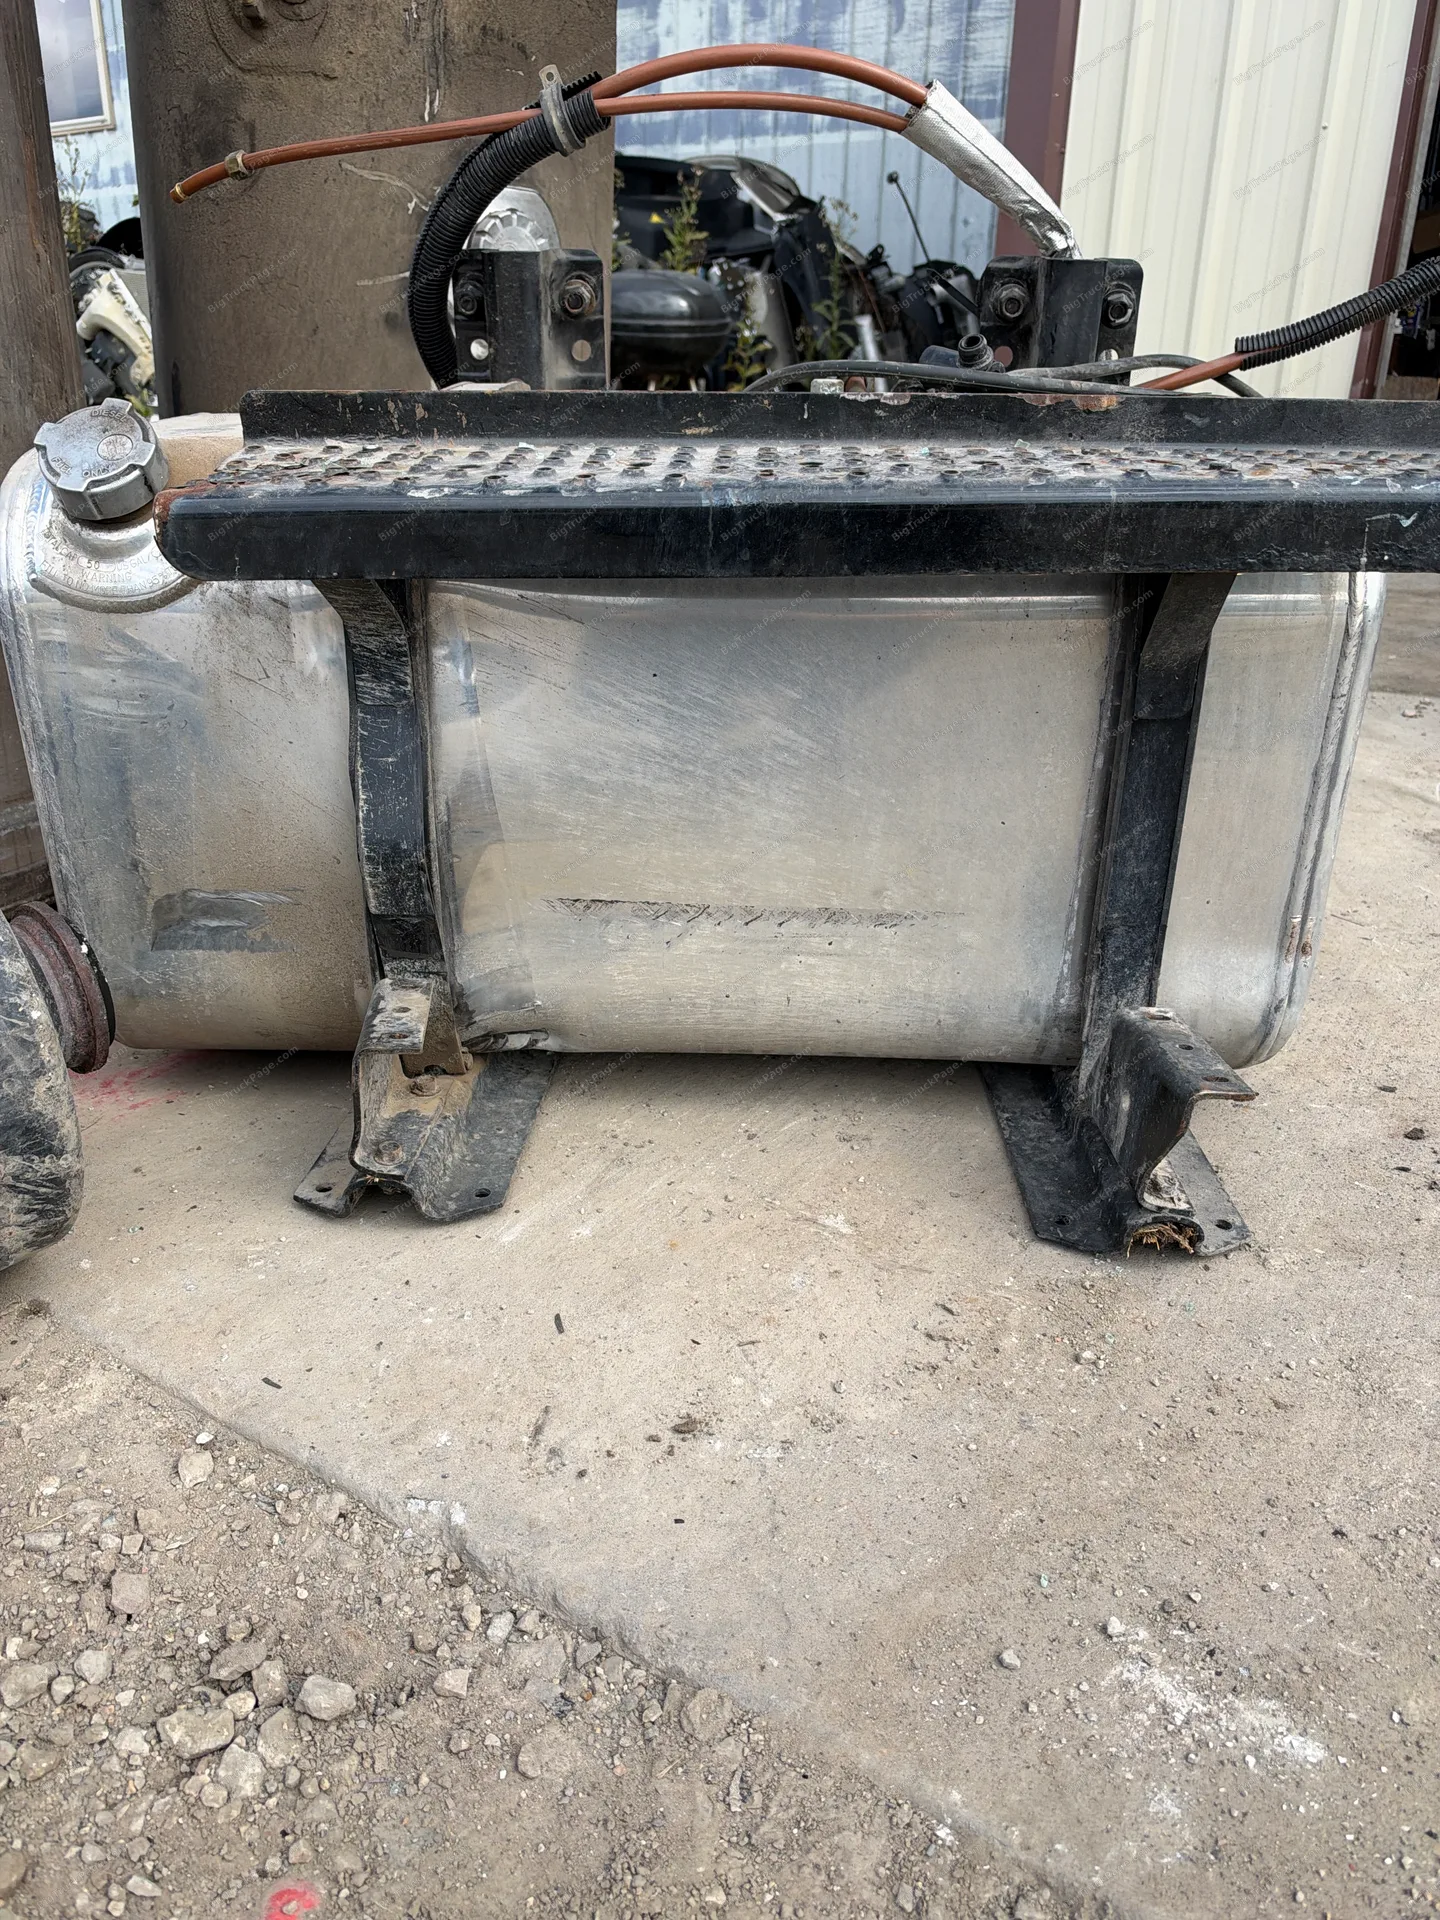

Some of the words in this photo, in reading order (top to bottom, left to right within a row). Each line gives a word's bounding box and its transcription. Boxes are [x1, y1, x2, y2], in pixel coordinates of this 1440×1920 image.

[91, 408, 127, 423] DIESEL
[51, 456, 73, 476] FUEL
[82, 465, 110, 479] ONLY
[86, 559, 100, 570] 50
[81, 568, 132, 583] WARNING
